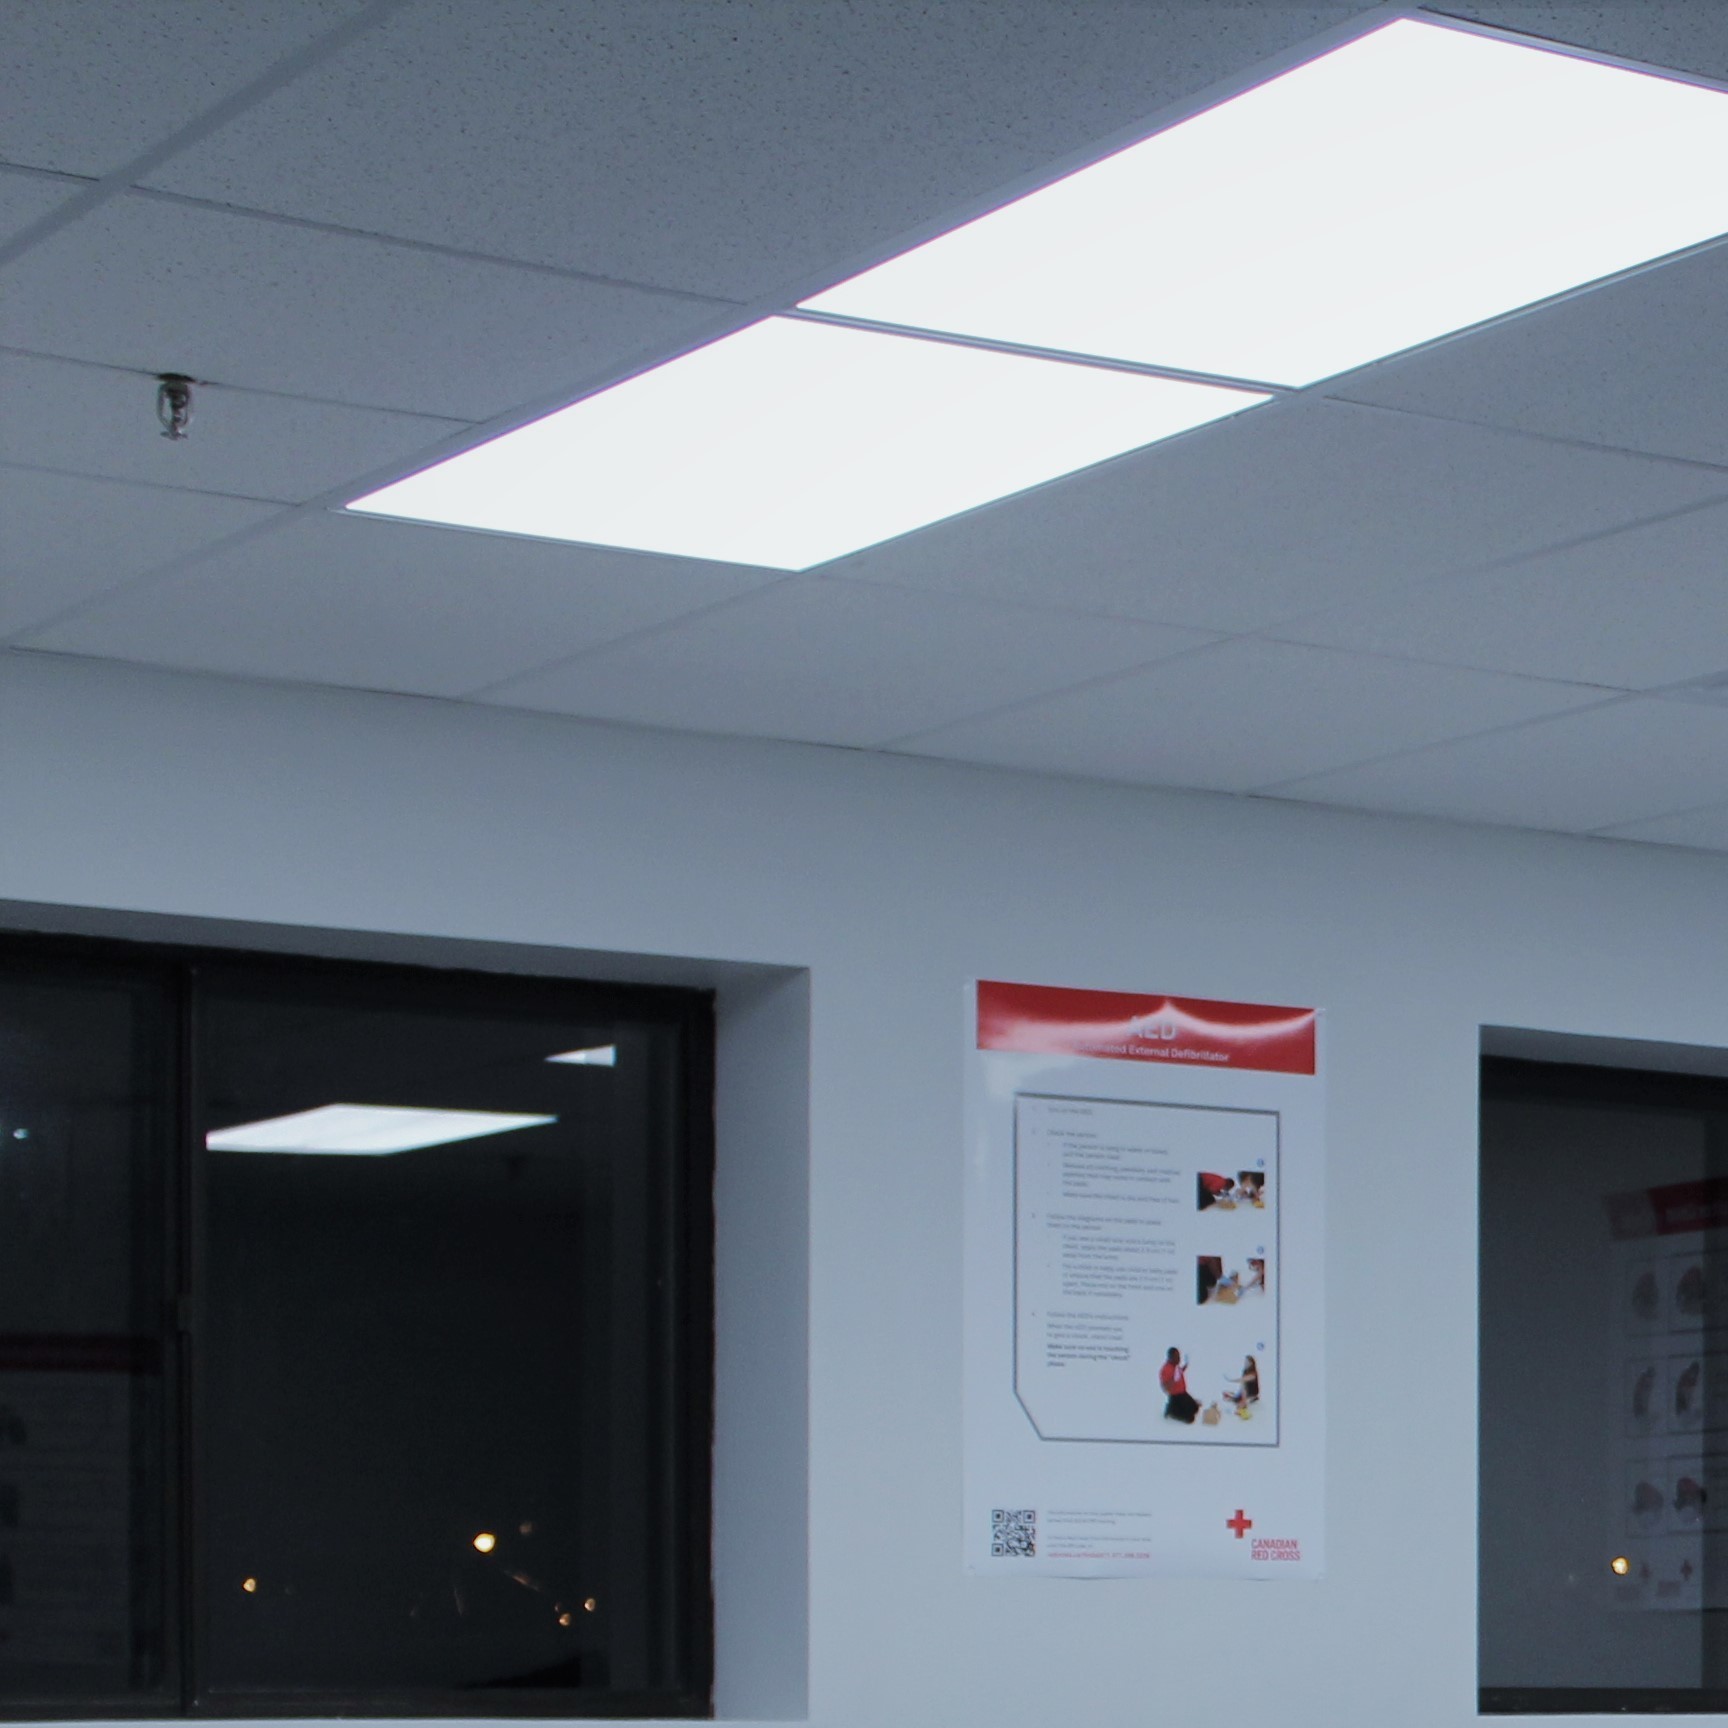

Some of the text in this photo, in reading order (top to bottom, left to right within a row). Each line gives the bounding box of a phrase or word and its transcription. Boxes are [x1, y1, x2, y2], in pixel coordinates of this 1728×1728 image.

[1127, 1016, 1177, 1040] AED
[1073, 1041, 1230, 1062] tomated External Defibrillator
[1251, 1539, 1298, 1549] CANADIAN
[1251, 1550, 1301, 1561] RED CROSS
